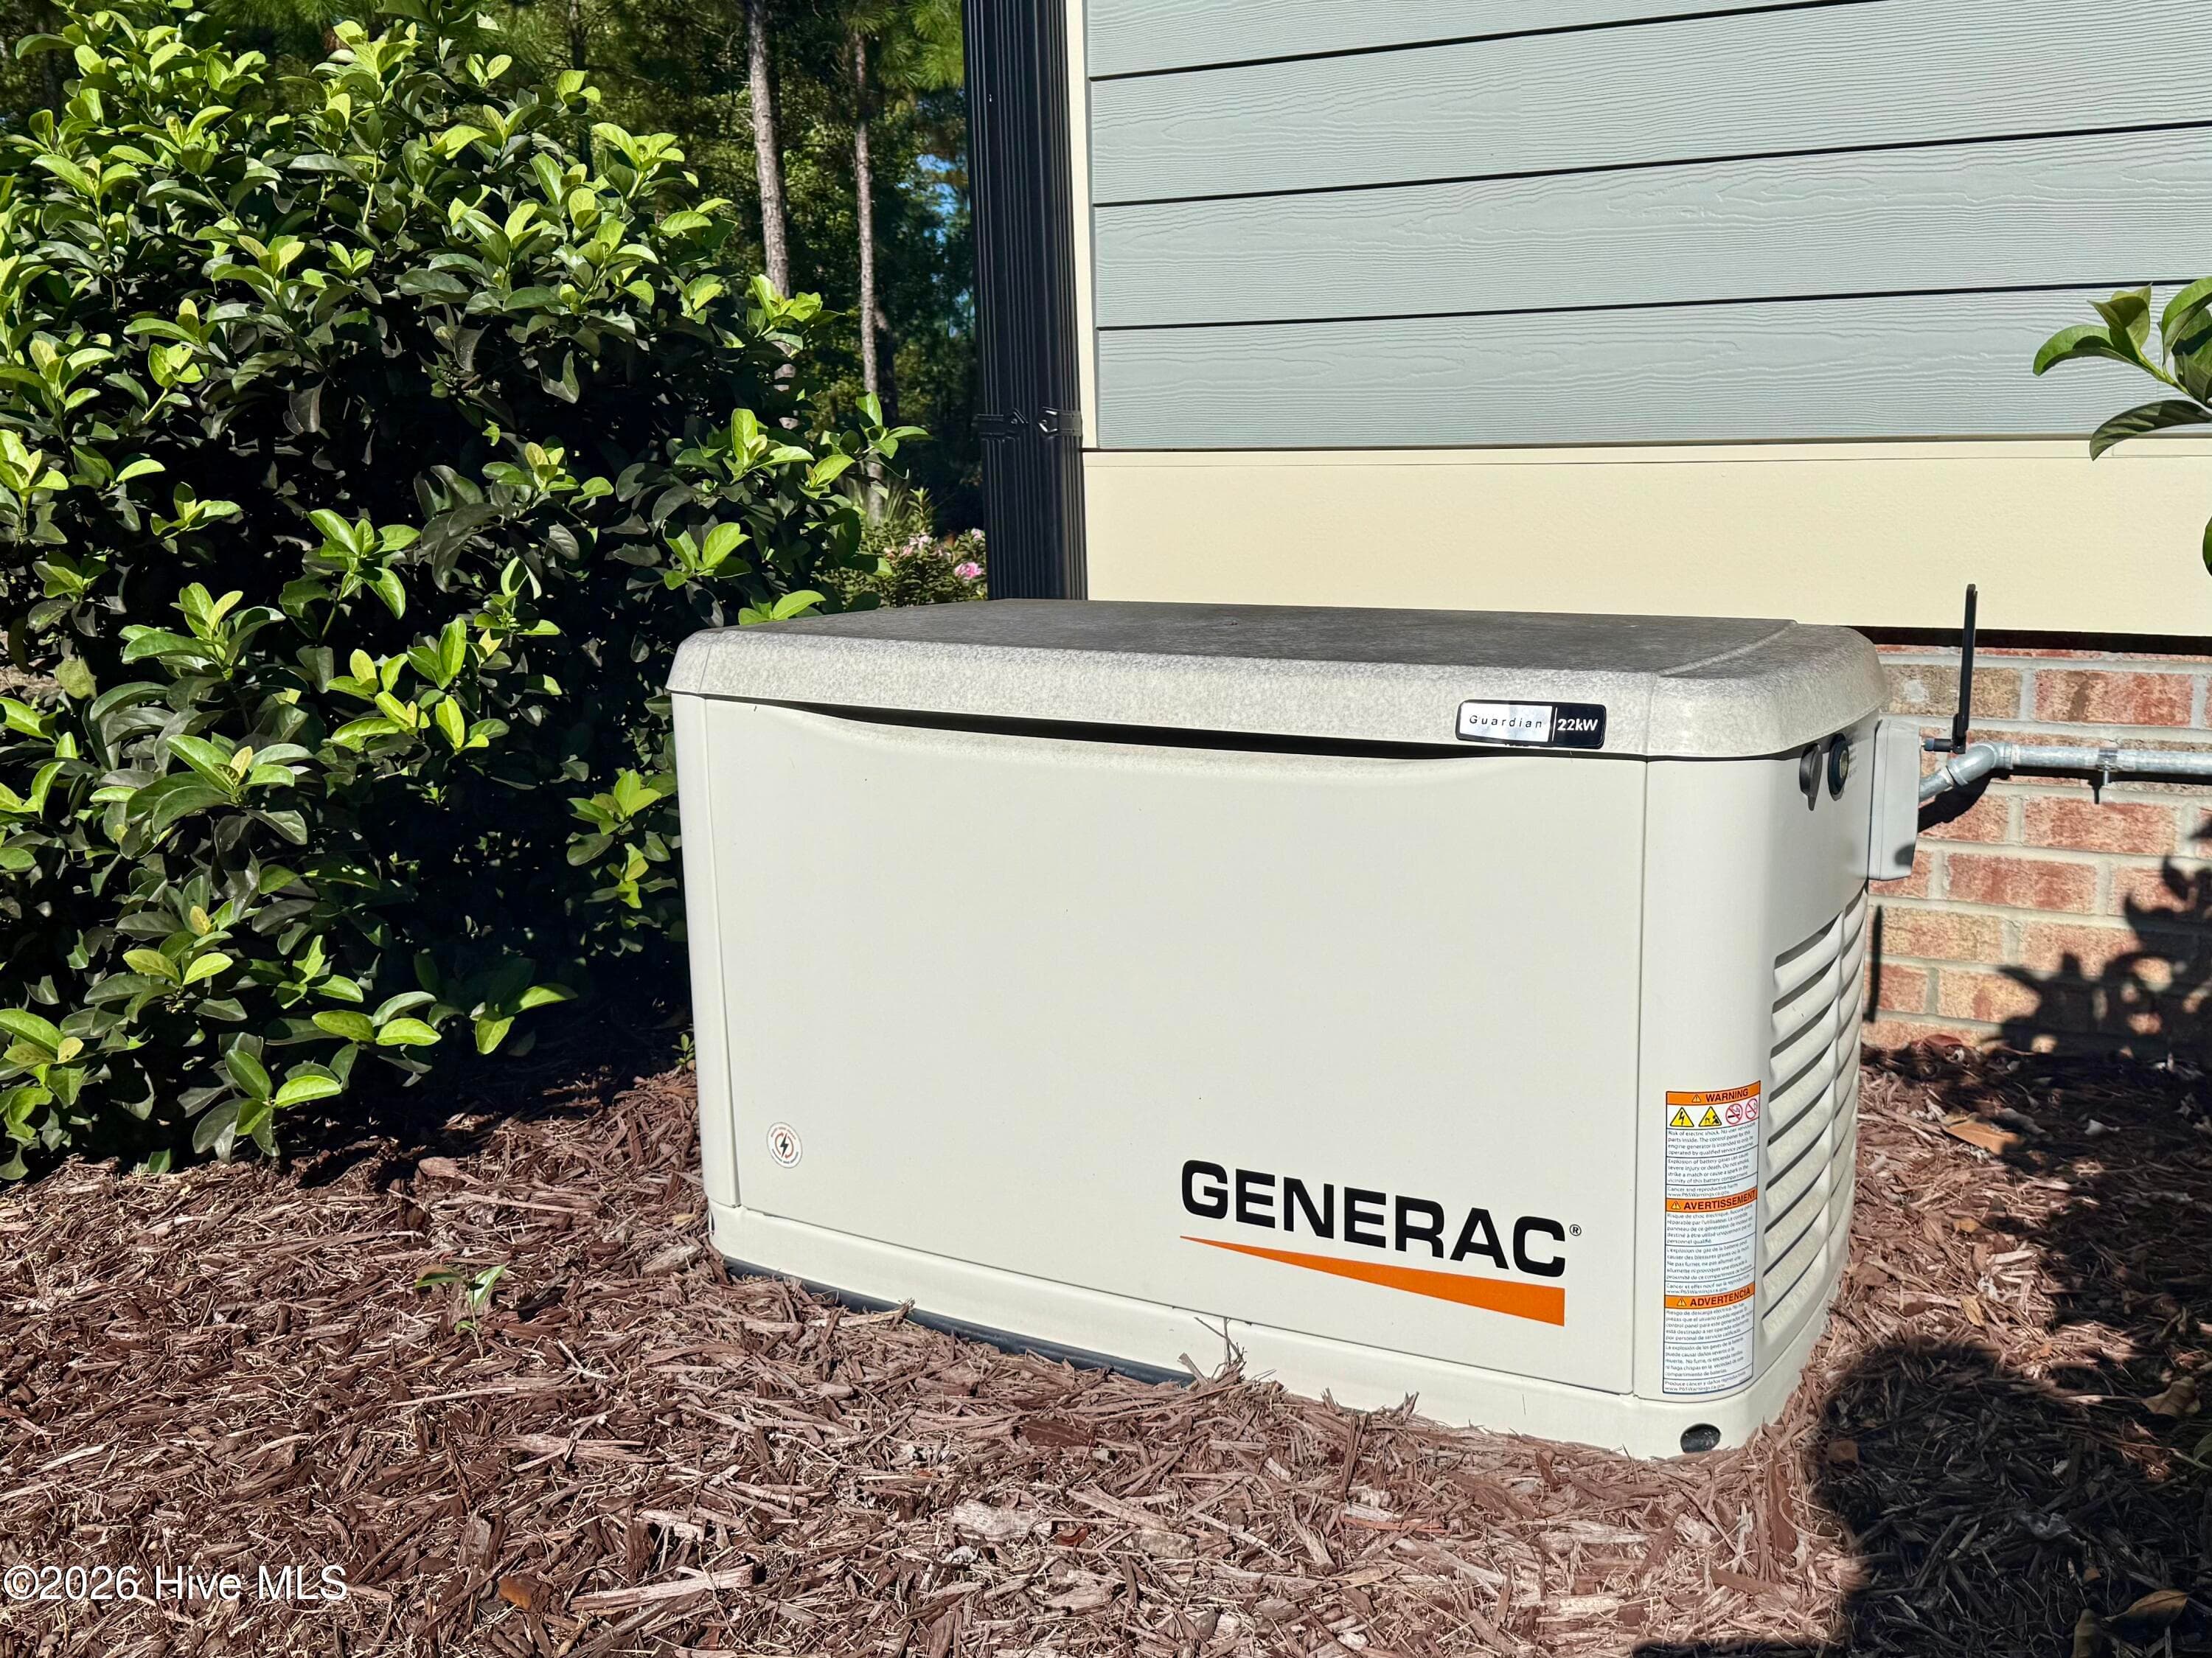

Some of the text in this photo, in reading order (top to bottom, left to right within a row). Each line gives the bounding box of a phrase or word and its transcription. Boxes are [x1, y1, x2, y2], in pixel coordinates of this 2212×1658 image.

[1469, 714, 1599, 731] Guardian 22kW
[1705, 1088, 1748, 1102] WARNING
[1684, 1191, 1756, 1210] AVERTISSEMENT
[1690, 1287, 1750, 1306] ADVERTENCIA
